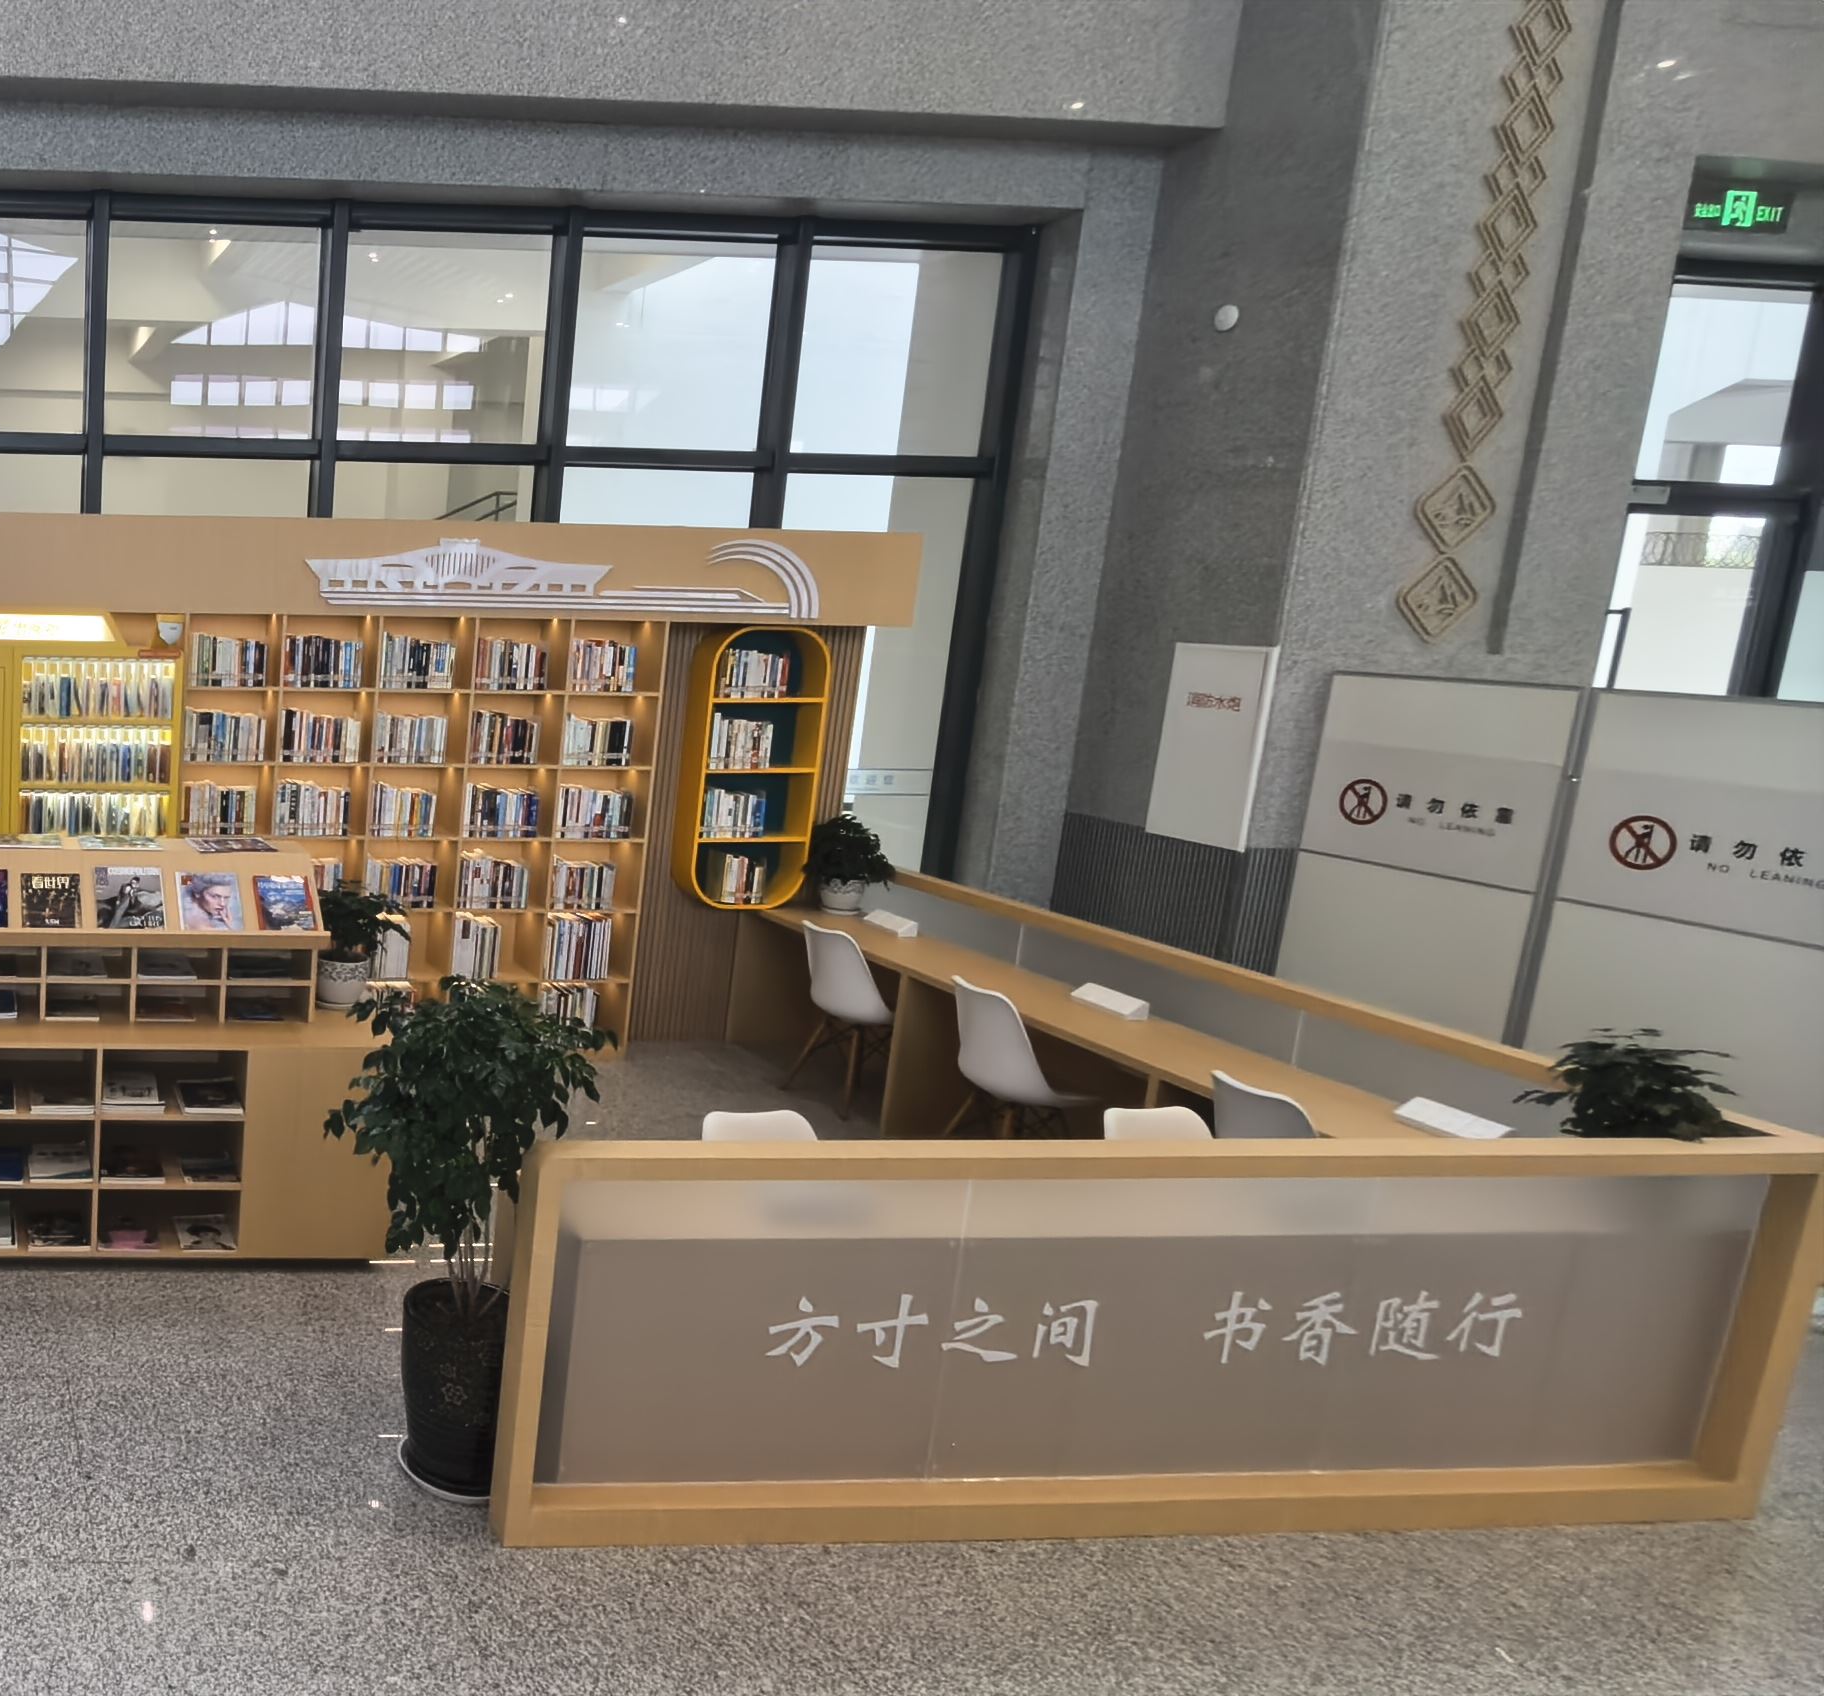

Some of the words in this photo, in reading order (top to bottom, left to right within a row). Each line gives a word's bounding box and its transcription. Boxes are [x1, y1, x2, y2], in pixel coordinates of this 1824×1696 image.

[1756, 206, 1784, 222] EXIT
[1395, 793, 1515, 825] 请勿依靠
[1407, 816, 1425, 827] NO
[1438, 822, 1496, 837] LEANING
[31, 875, 70, 889] 看世界
[1706, 862, 1731, 874] NO
[1749, 868, 1824, 890] LEANING
[764, 1292, 1102, 1369] 方寸之间
[1202, 1290, 1525, 1366] 书香随行
